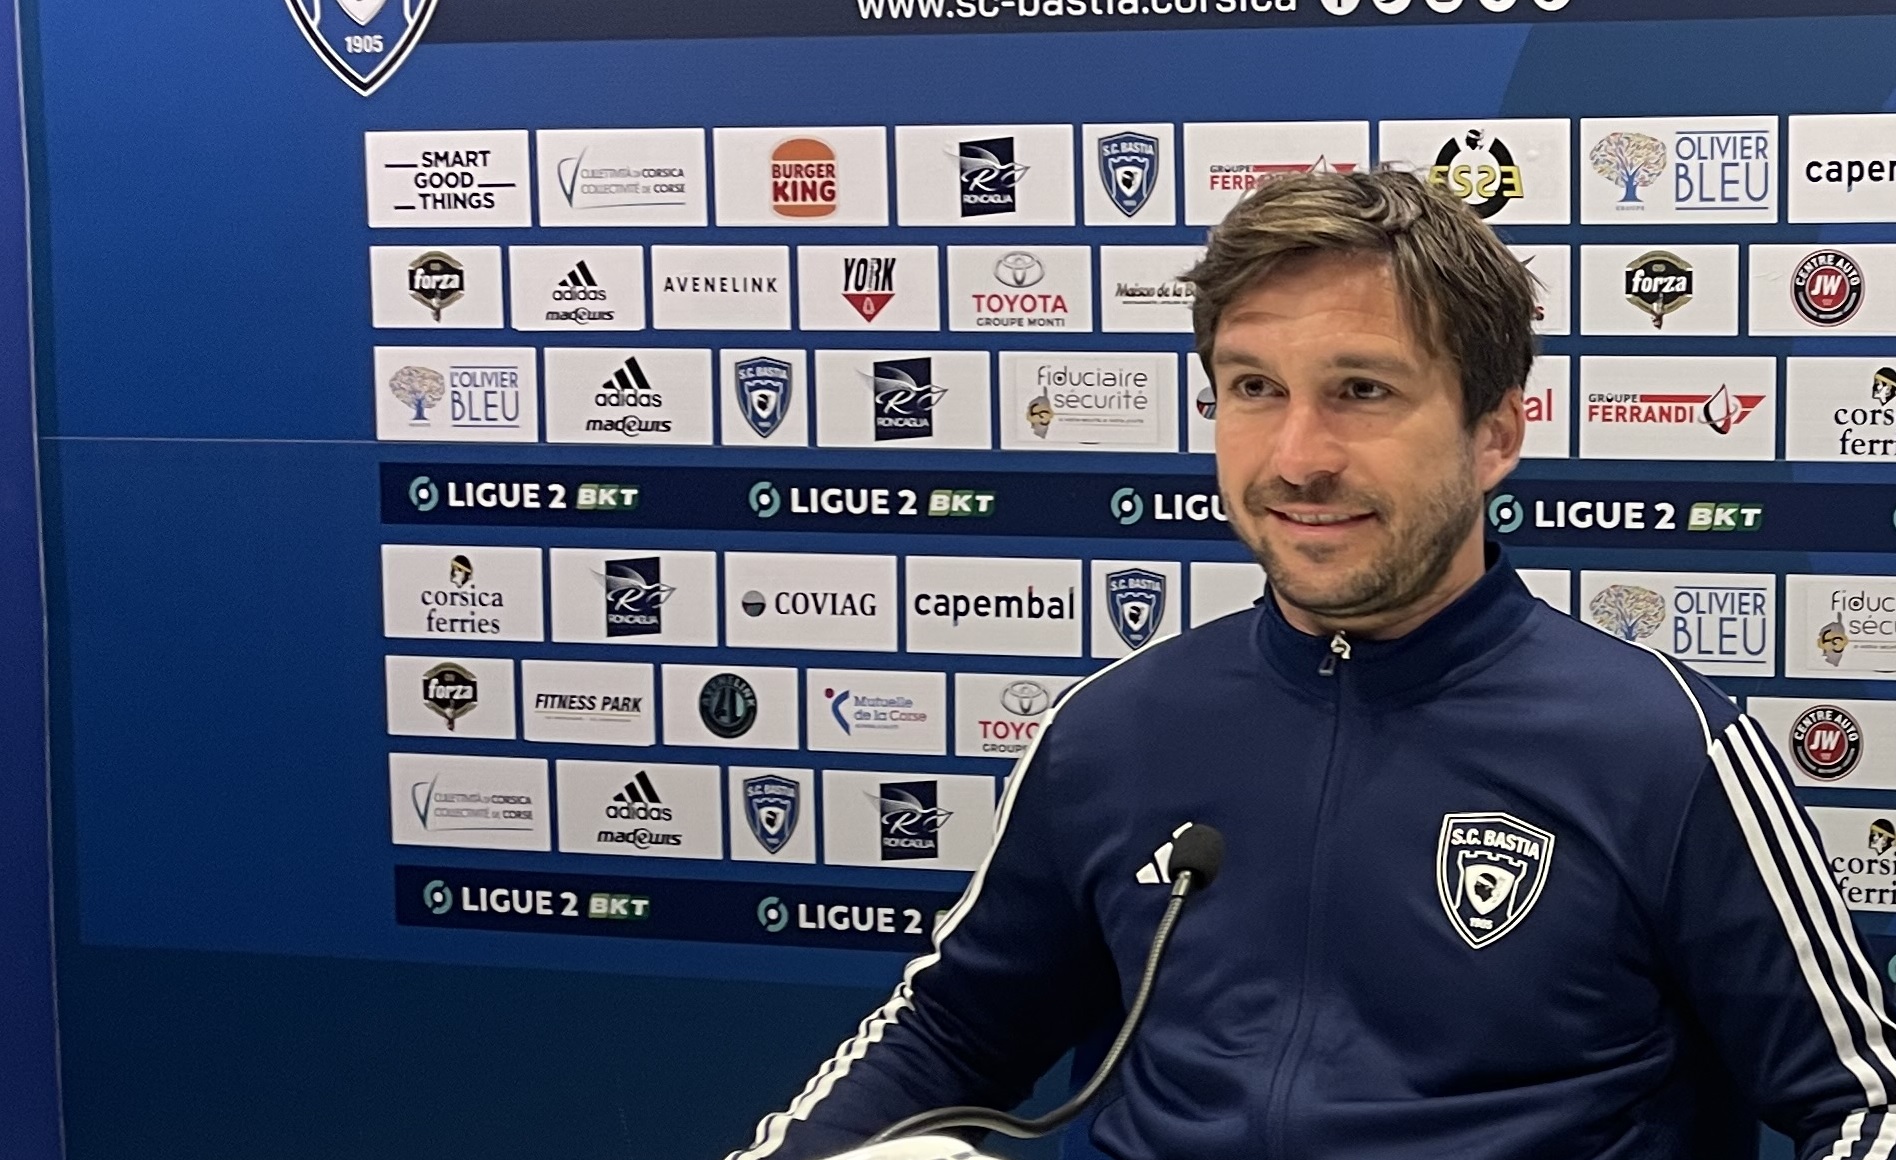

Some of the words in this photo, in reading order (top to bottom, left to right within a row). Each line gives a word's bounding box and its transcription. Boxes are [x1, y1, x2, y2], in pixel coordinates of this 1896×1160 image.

[344, 36, 384, 54] 1905
[422, 151, 491, 168] SMART
[1675, 136, 1769, 161] OLIVIER
[415, 172, 475, 190] GOOD
[771, 164, 836, 181] BURGER
[1675, 162, 1769, 202] BLEU
[419, 193, 495, 210] THINGS
[772, 180, 837, 203] KING
[664, 276, 778, 293] AVENELINK
[843, 257, 896, 292] YORK
[1631, 271, 1687, 295] forza
[972, 294, 1068, 315] TOYOTA
[977, 317, 1025, 327] GROUPE
[1028, 317, 1065, 327] MONTI
[1037, 365, 1148, 388] fiduciaire
[451, 391, 520, 422] BLEU
[595, 390, 662, 408] adidas
[1053, 389, 1149, 411] sécurité
[791, 488, 891, 514] LIGUE
[899, 490, 917, 515] 2
[930, 494, 993, 514] BKT
[1535, 502, 1644, 529] LIGUE
[1655, 503, 1675, 530] 2
[1690, 507, 1761, 527] BKT
[421, 585, 504, 608] corsica
[775, 592, 877, 617] COVIAG
[914, 586, 1075, 626] capembal
[1674, 591, 1766, 616] OLIVIER
[426, 609, 500, 634] ferries
[1674, 620, 1767, 656] BLEU
[535, 694, 596, 712] FITNESS
[601, 695, 642, 713] PARK
[1451, 829, 1481, 846] S.C.
[1483, 830, 1540, 860] BASTIA
[461, 887, 553, 914] LIGUE
[560, 892, 579, 915] 2
[590, 897, 649, 916] BKT
